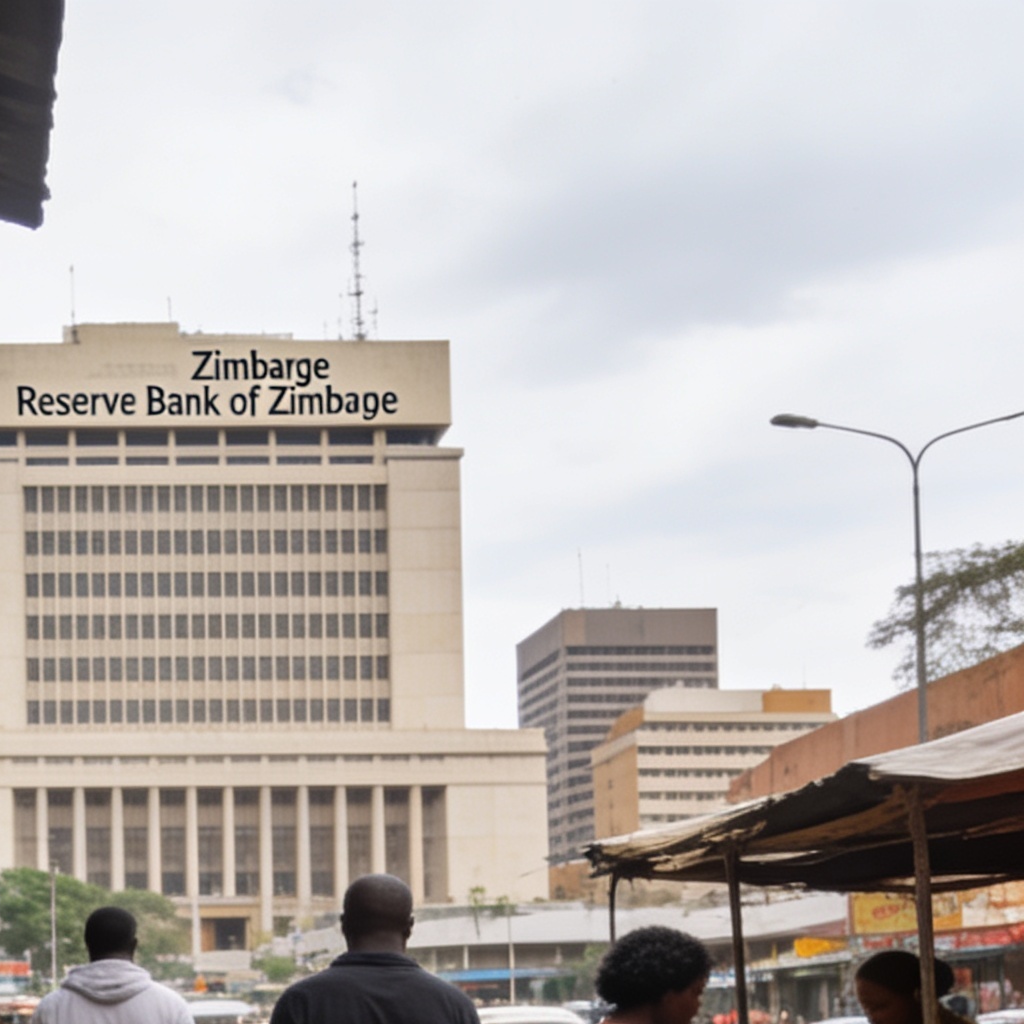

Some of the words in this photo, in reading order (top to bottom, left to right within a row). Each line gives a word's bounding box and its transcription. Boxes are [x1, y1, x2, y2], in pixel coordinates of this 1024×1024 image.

[191, 350, 330, 387] Zimbarge
[17, 386, 136, 416] Reserve
[146, 385, 221, 416] Bank
[230, 385, 261, 417] of
[268, 385, 399, 420] Zimbage
